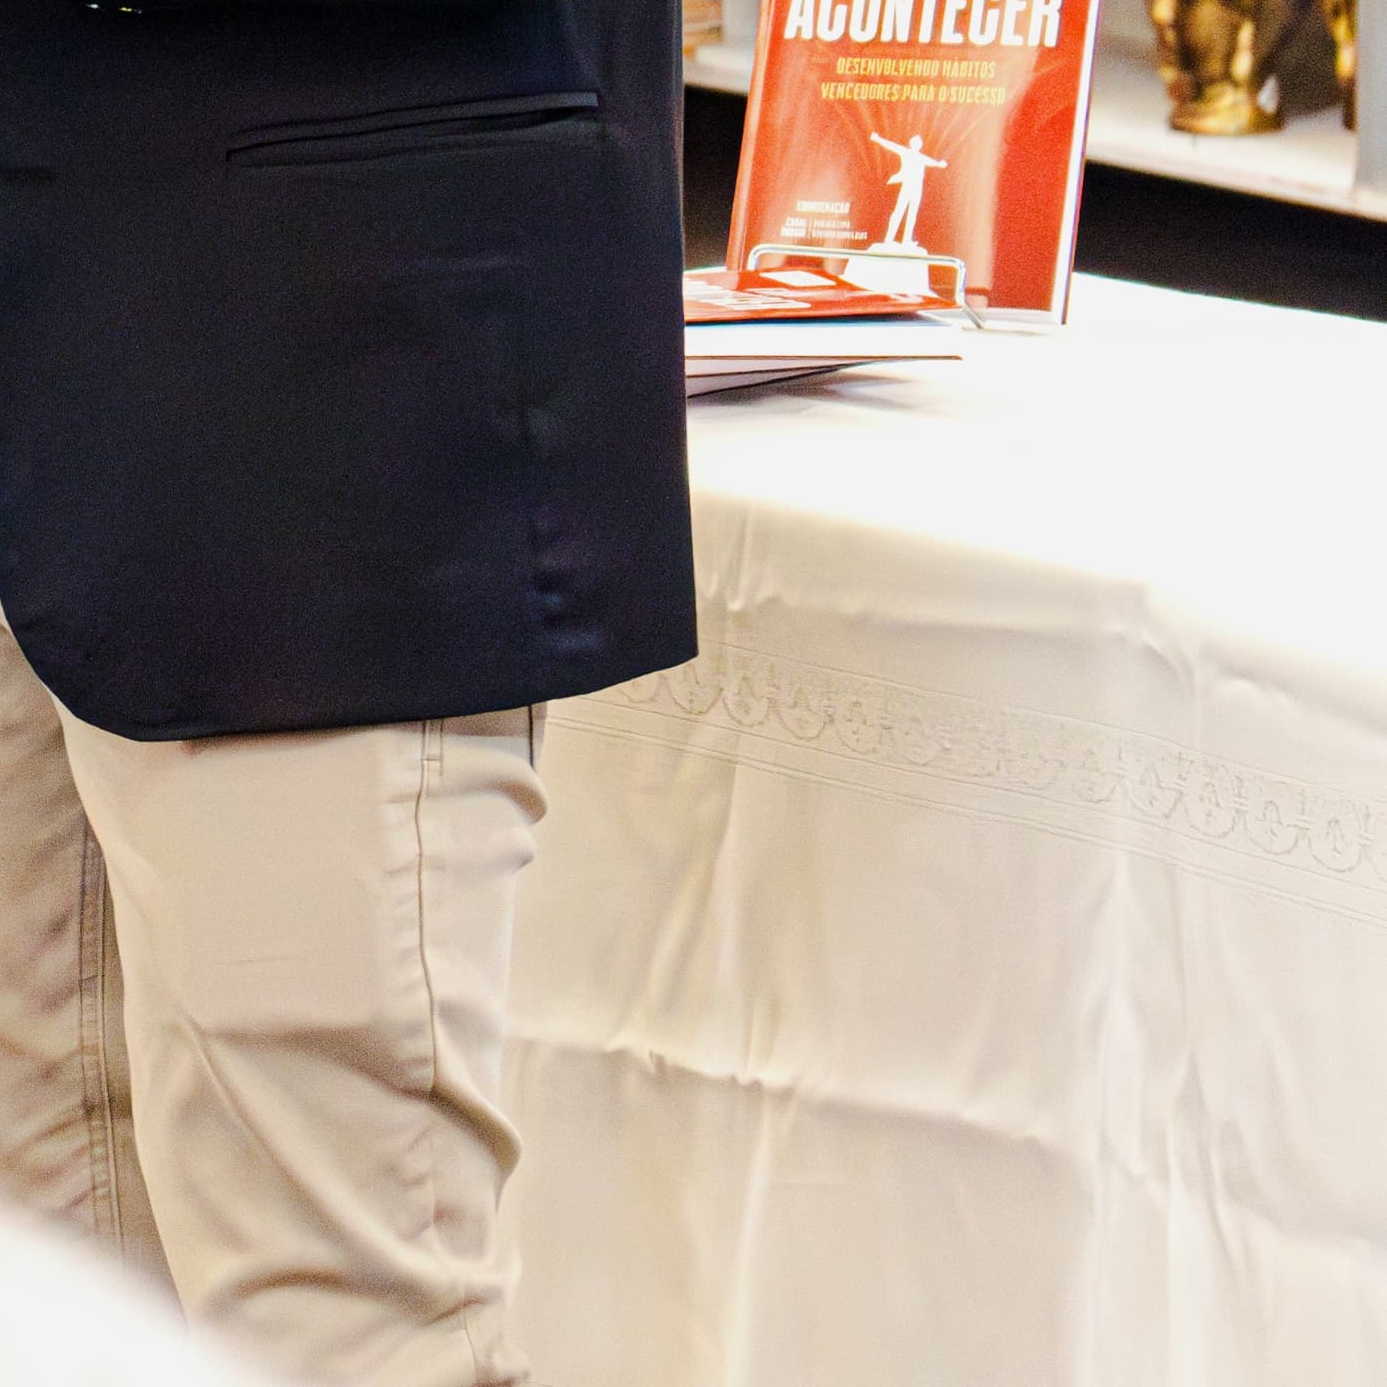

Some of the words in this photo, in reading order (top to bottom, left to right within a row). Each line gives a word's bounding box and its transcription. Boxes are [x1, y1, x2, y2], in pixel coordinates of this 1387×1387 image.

[836, 57, 939, 76] DESENVOLVENDO
[821, 82, 900, 101] VENCEDORES
[902, 84, 935, 103] PARA
[937, 86, 949, 102] O
[949, 86, 1007, 106] SUCESSO
